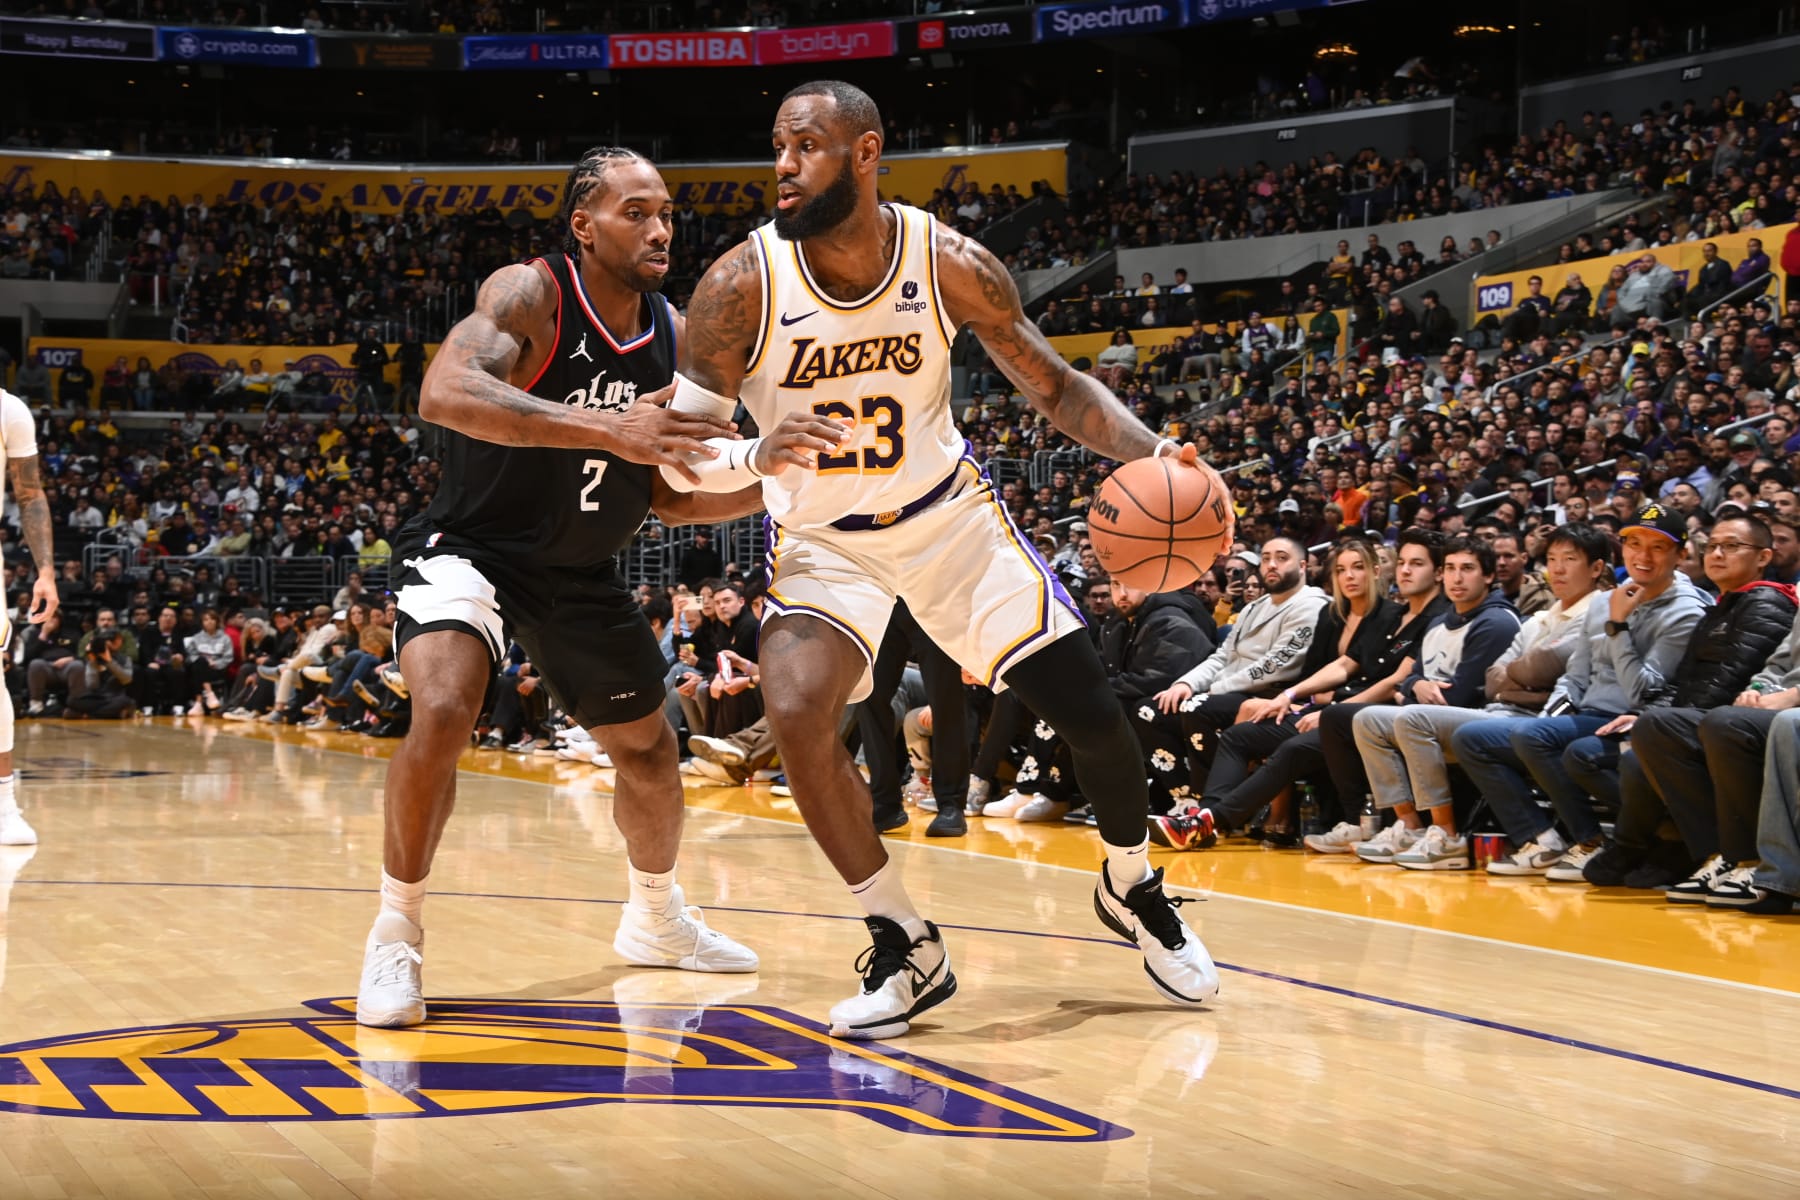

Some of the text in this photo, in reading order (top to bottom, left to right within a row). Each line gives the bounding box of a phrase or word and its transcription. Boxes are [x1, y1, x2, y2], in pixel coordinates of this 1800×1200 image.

[948, 22, 1012, 39] TOYOTA
[1052, 4, 1163, 36] Spectrum
[24, 33, 128, 52] Happy Birthday
[203, 41, 298, 55] crypto.com
[541, 44, 601, 60] ULTRA
[615, 38, 747, 62] TOSHIBA
[780, 31, 870, 56] boldyn
[227, 180, 326, 204] LOS
[344, 184, 559, 208] ANGELES
[895, 301, 927, 313] bibigo
[1480, 285, 1511, 307] 109
[778, 332, 924, 389] LAKERS
[811, 394, 906, 477] 23
[581, 459, 608, 511] 2
